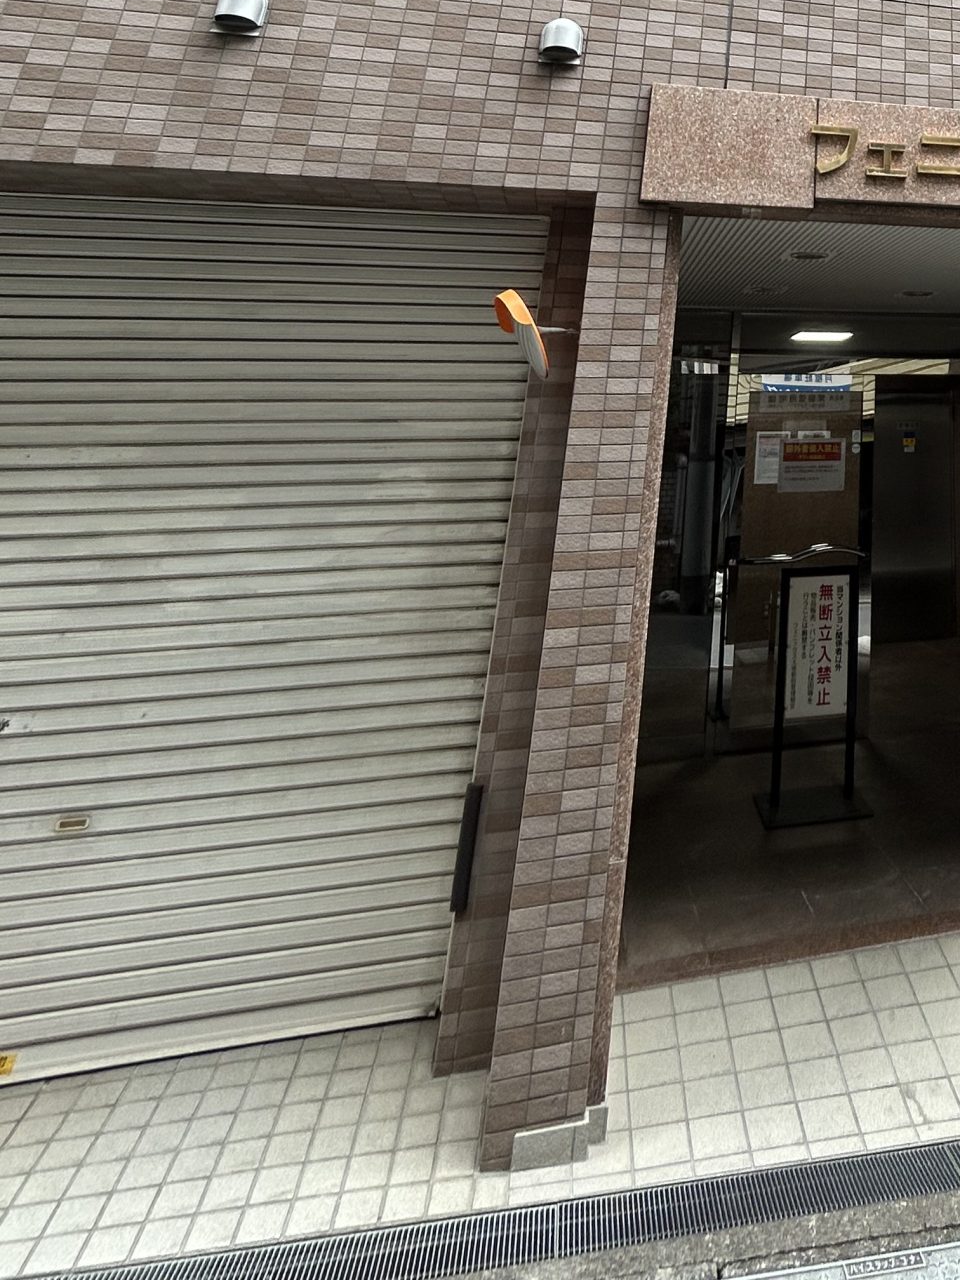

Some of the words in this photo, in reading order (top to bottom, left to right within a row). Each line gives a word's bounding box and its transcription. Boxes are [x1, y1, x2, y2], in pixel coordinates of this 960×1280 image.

[816, 583, 834, 706] 無断立入禁止
[834, 585, 844, 672] 当マンション関係者以外
